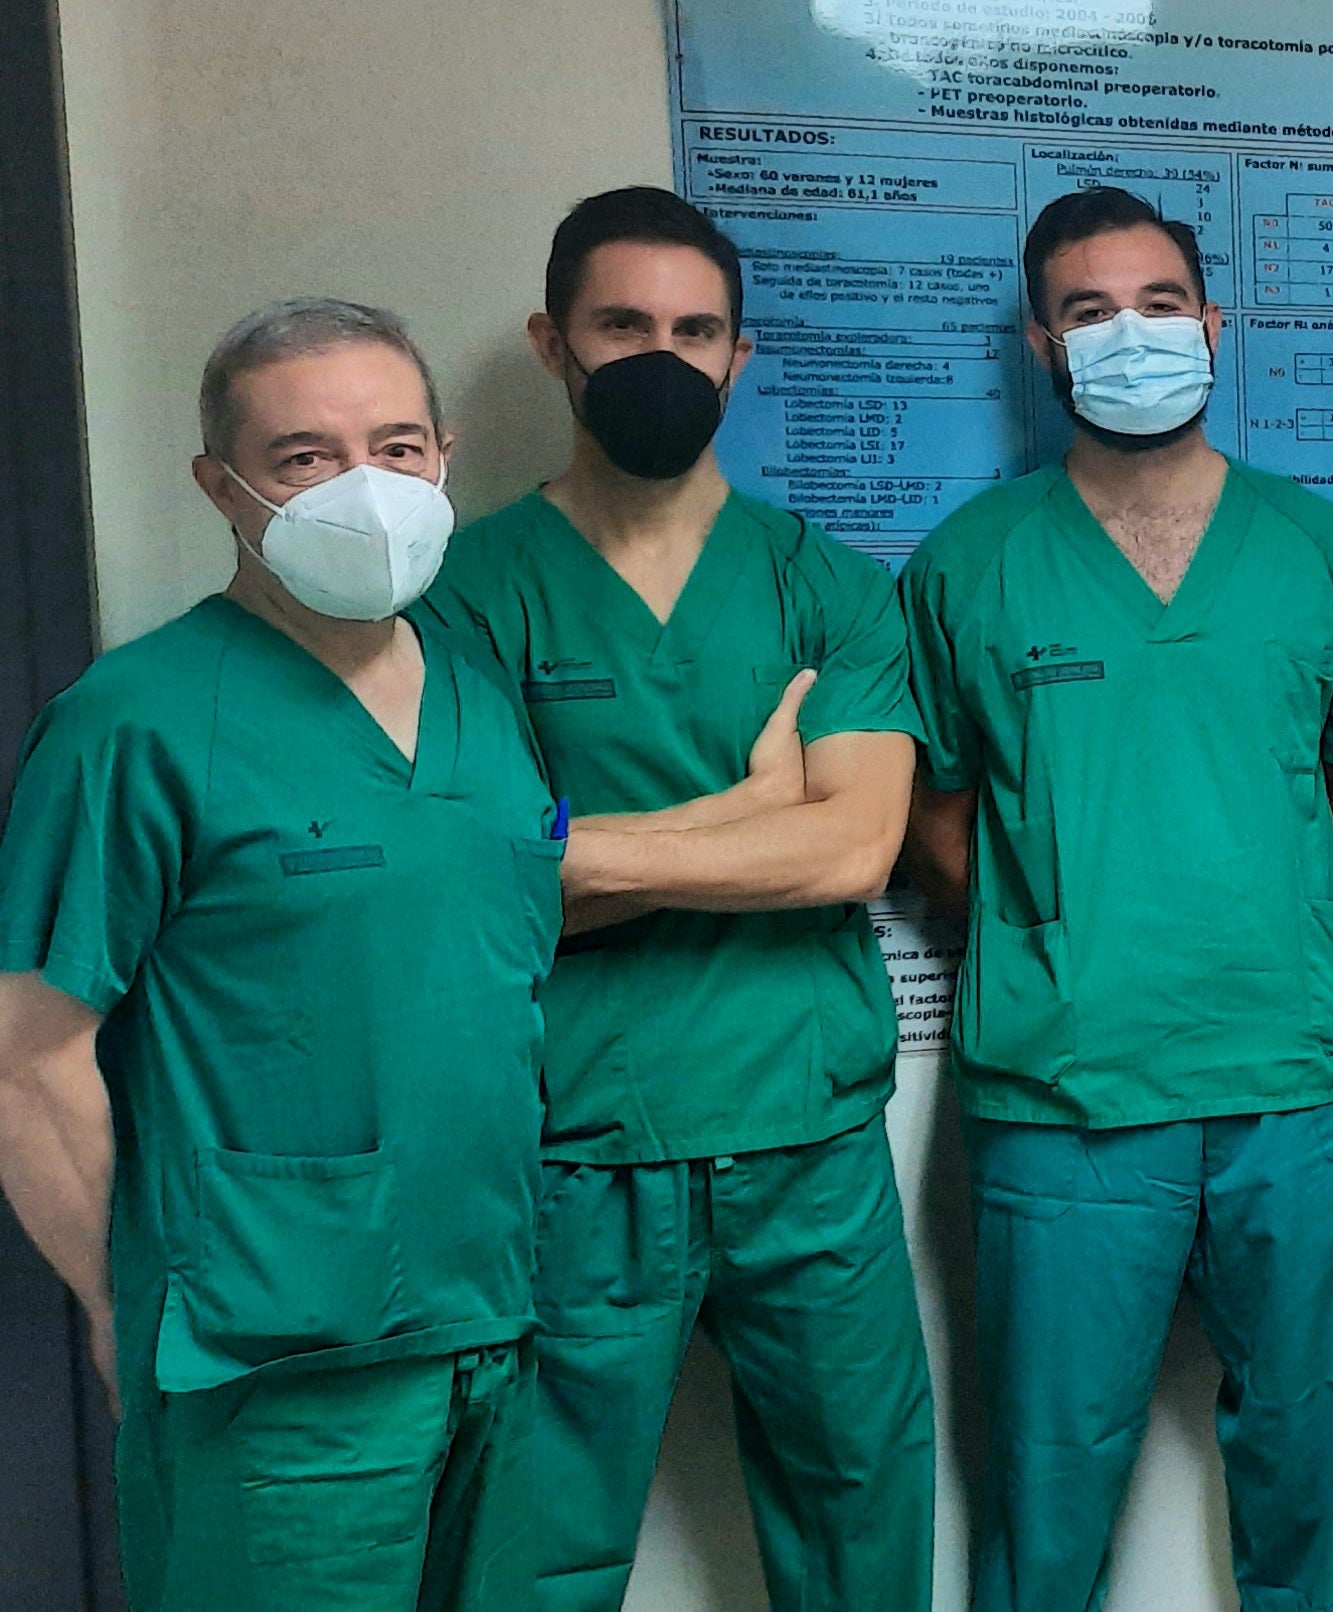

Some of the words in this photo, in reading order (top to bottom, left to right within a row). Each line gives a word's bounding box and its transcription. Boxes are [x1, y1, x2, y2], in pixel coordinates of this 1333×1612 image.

[1183, 33, 1213, 48] y/o
[1013, 58, 1119, 75] disponemos:
[930, 69, 963, 83] TAC
[968, 73, 1099, 91] toracabdominal
[1104, 82, 1220, 99] preoperatorio.
[931, 88, 962, 101] PET
[968, 94, 1088, 109] preoperatorio.
[931, 105, 1008, 122] Muestras
[1014, 110, 1113, 128] histológicas
[1118, 116, 1198, 131] obtenidas
[1203, 121, 1277, 136] mediante
[699, 126, 836, 145] RESULTADOS:
[697, 153, 762, 166] Muestra:
[1245, 158, 1286, 170] Factor
[879, 175, 939, 189] mujeres
[1317, 220, 1333, 231] 50
[1322, 243, 1330, 253] 4
[1320, 264, 1333, 275] 17
[1250, 318, 1291, 329] Factor
